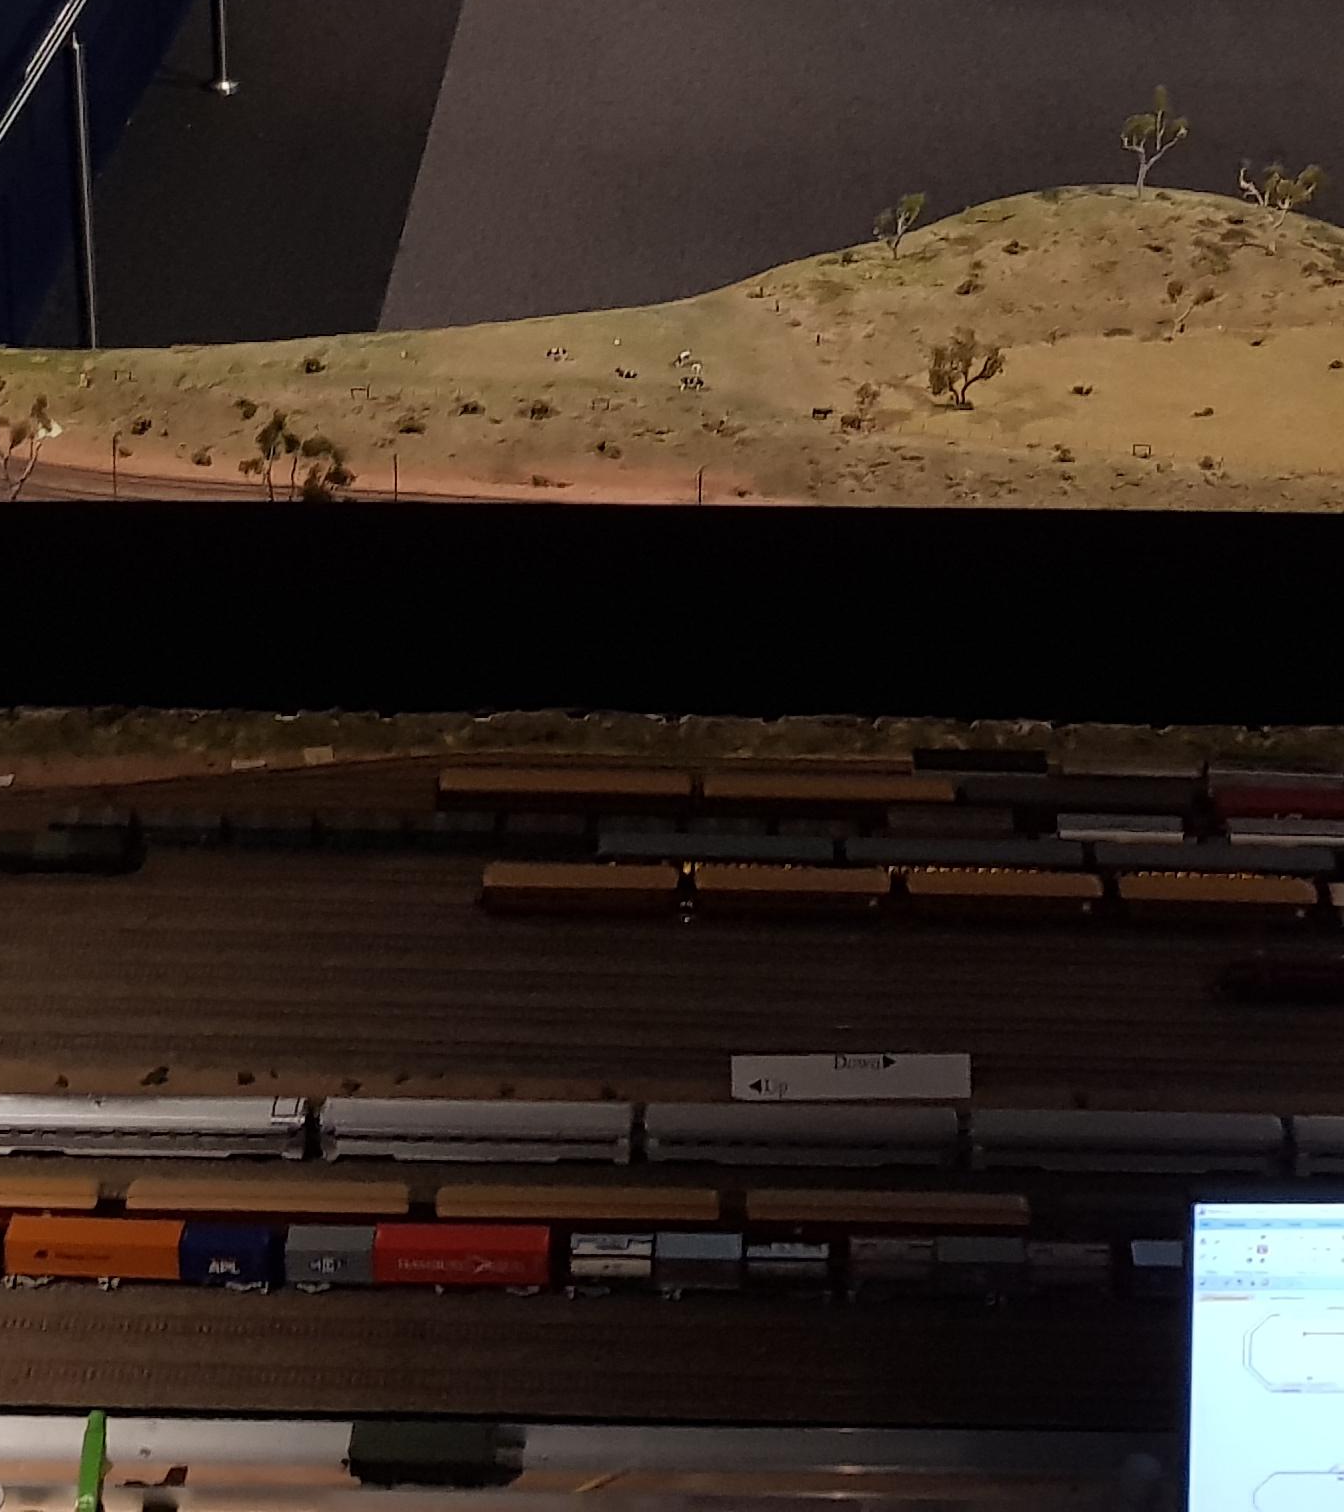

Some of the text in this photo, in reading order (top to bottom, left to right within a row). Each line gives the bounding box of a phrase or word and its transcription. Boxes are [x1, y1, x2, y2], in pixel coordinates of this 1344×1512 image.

[834, 1054, 882, 1071] Down
[763, 1078, 788, 1099] Up
[208, 1258, 241, 1275] APL
